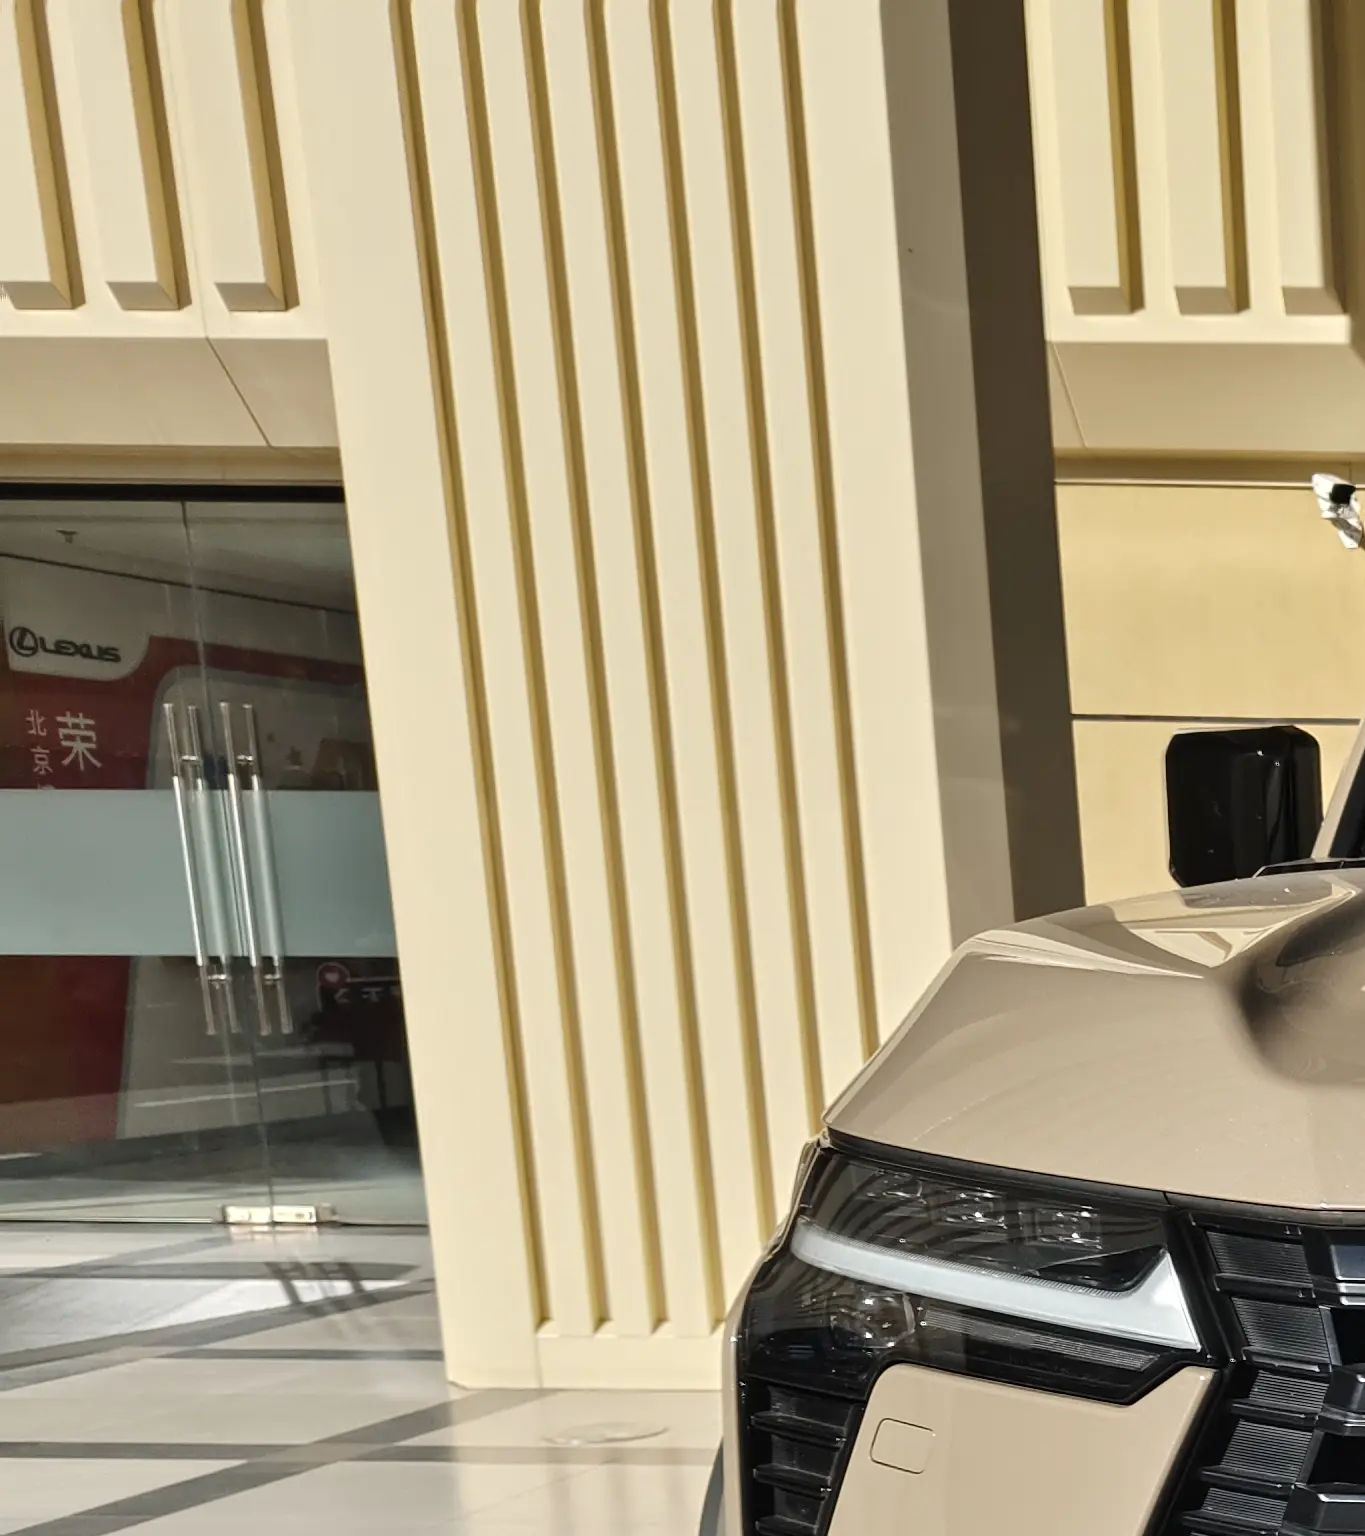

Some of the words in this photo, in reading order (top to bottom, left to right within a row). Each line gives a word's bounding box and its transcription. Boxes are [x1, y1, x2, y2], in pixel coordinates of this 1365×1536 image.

[39, 636, 122, 663] LEXUS
[25, 709, 54, 789] 北京
[56, 711, 103, 772] 荣
